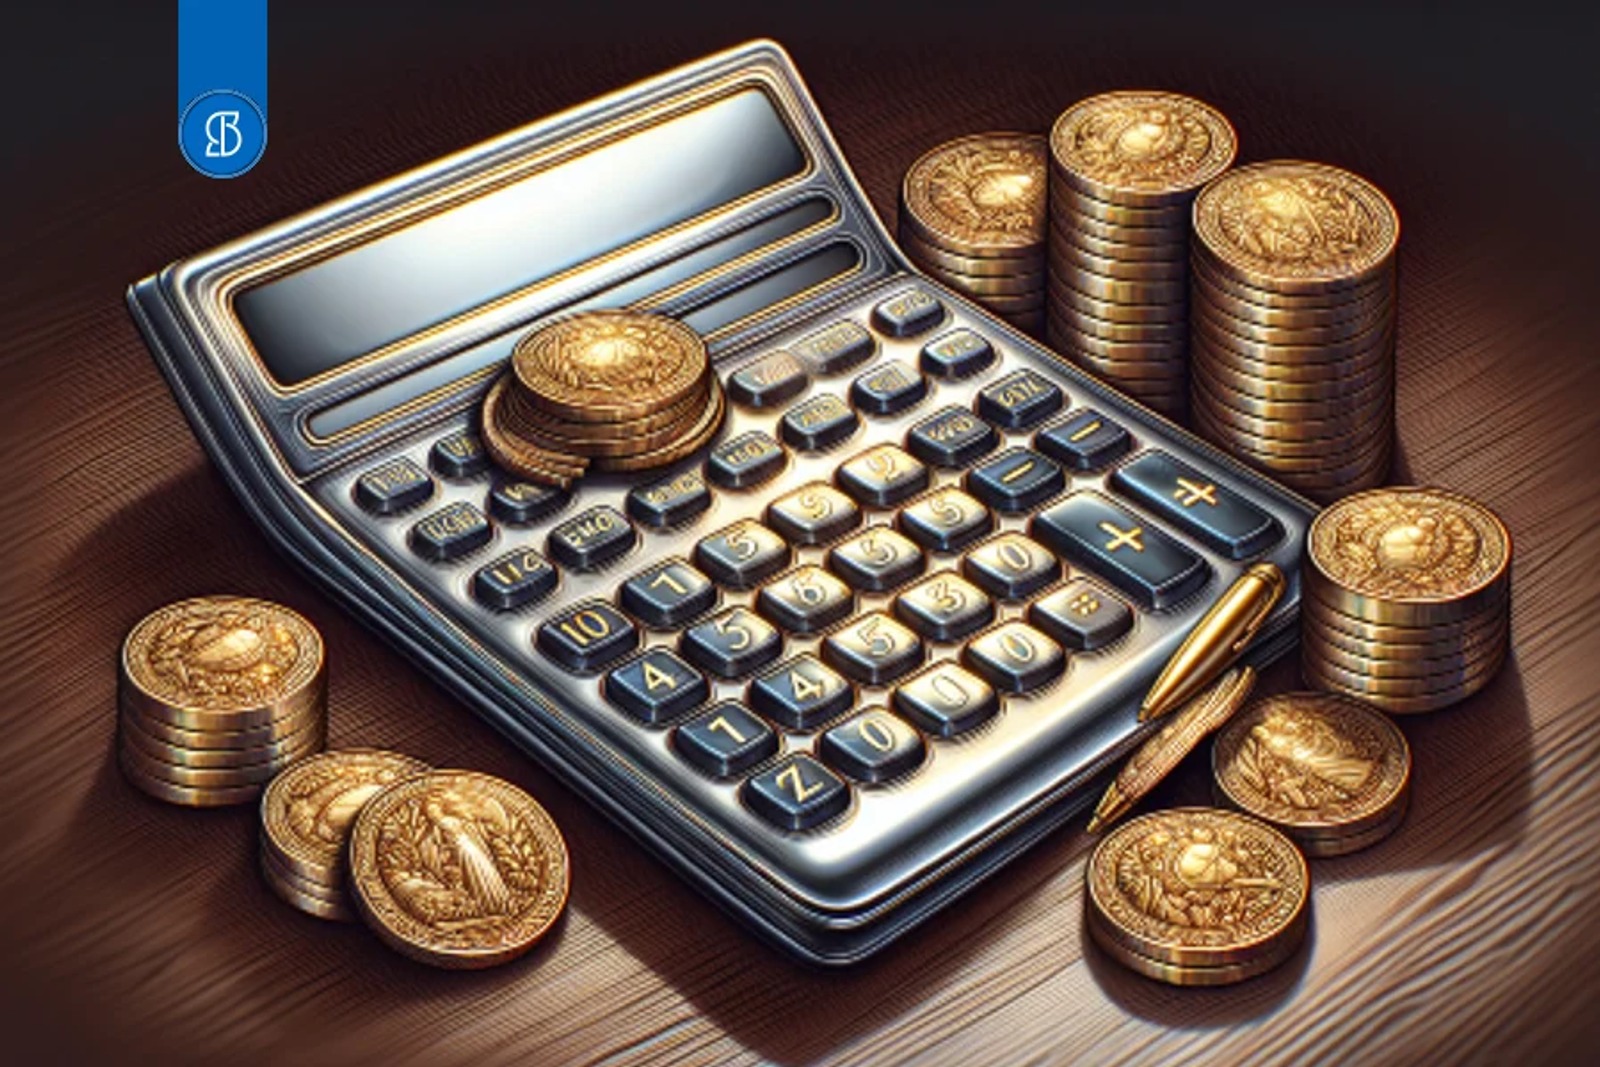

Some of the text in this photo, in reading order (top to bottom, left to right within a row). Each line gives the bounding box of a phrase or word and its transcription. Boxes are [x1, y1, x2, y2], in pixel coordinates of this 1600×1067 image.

[561, 611, 610, 647] 10
[641, 661, 678, 693] 4
[788, 672, 825, 701] 4
[858, 720, 897, 752] 0
